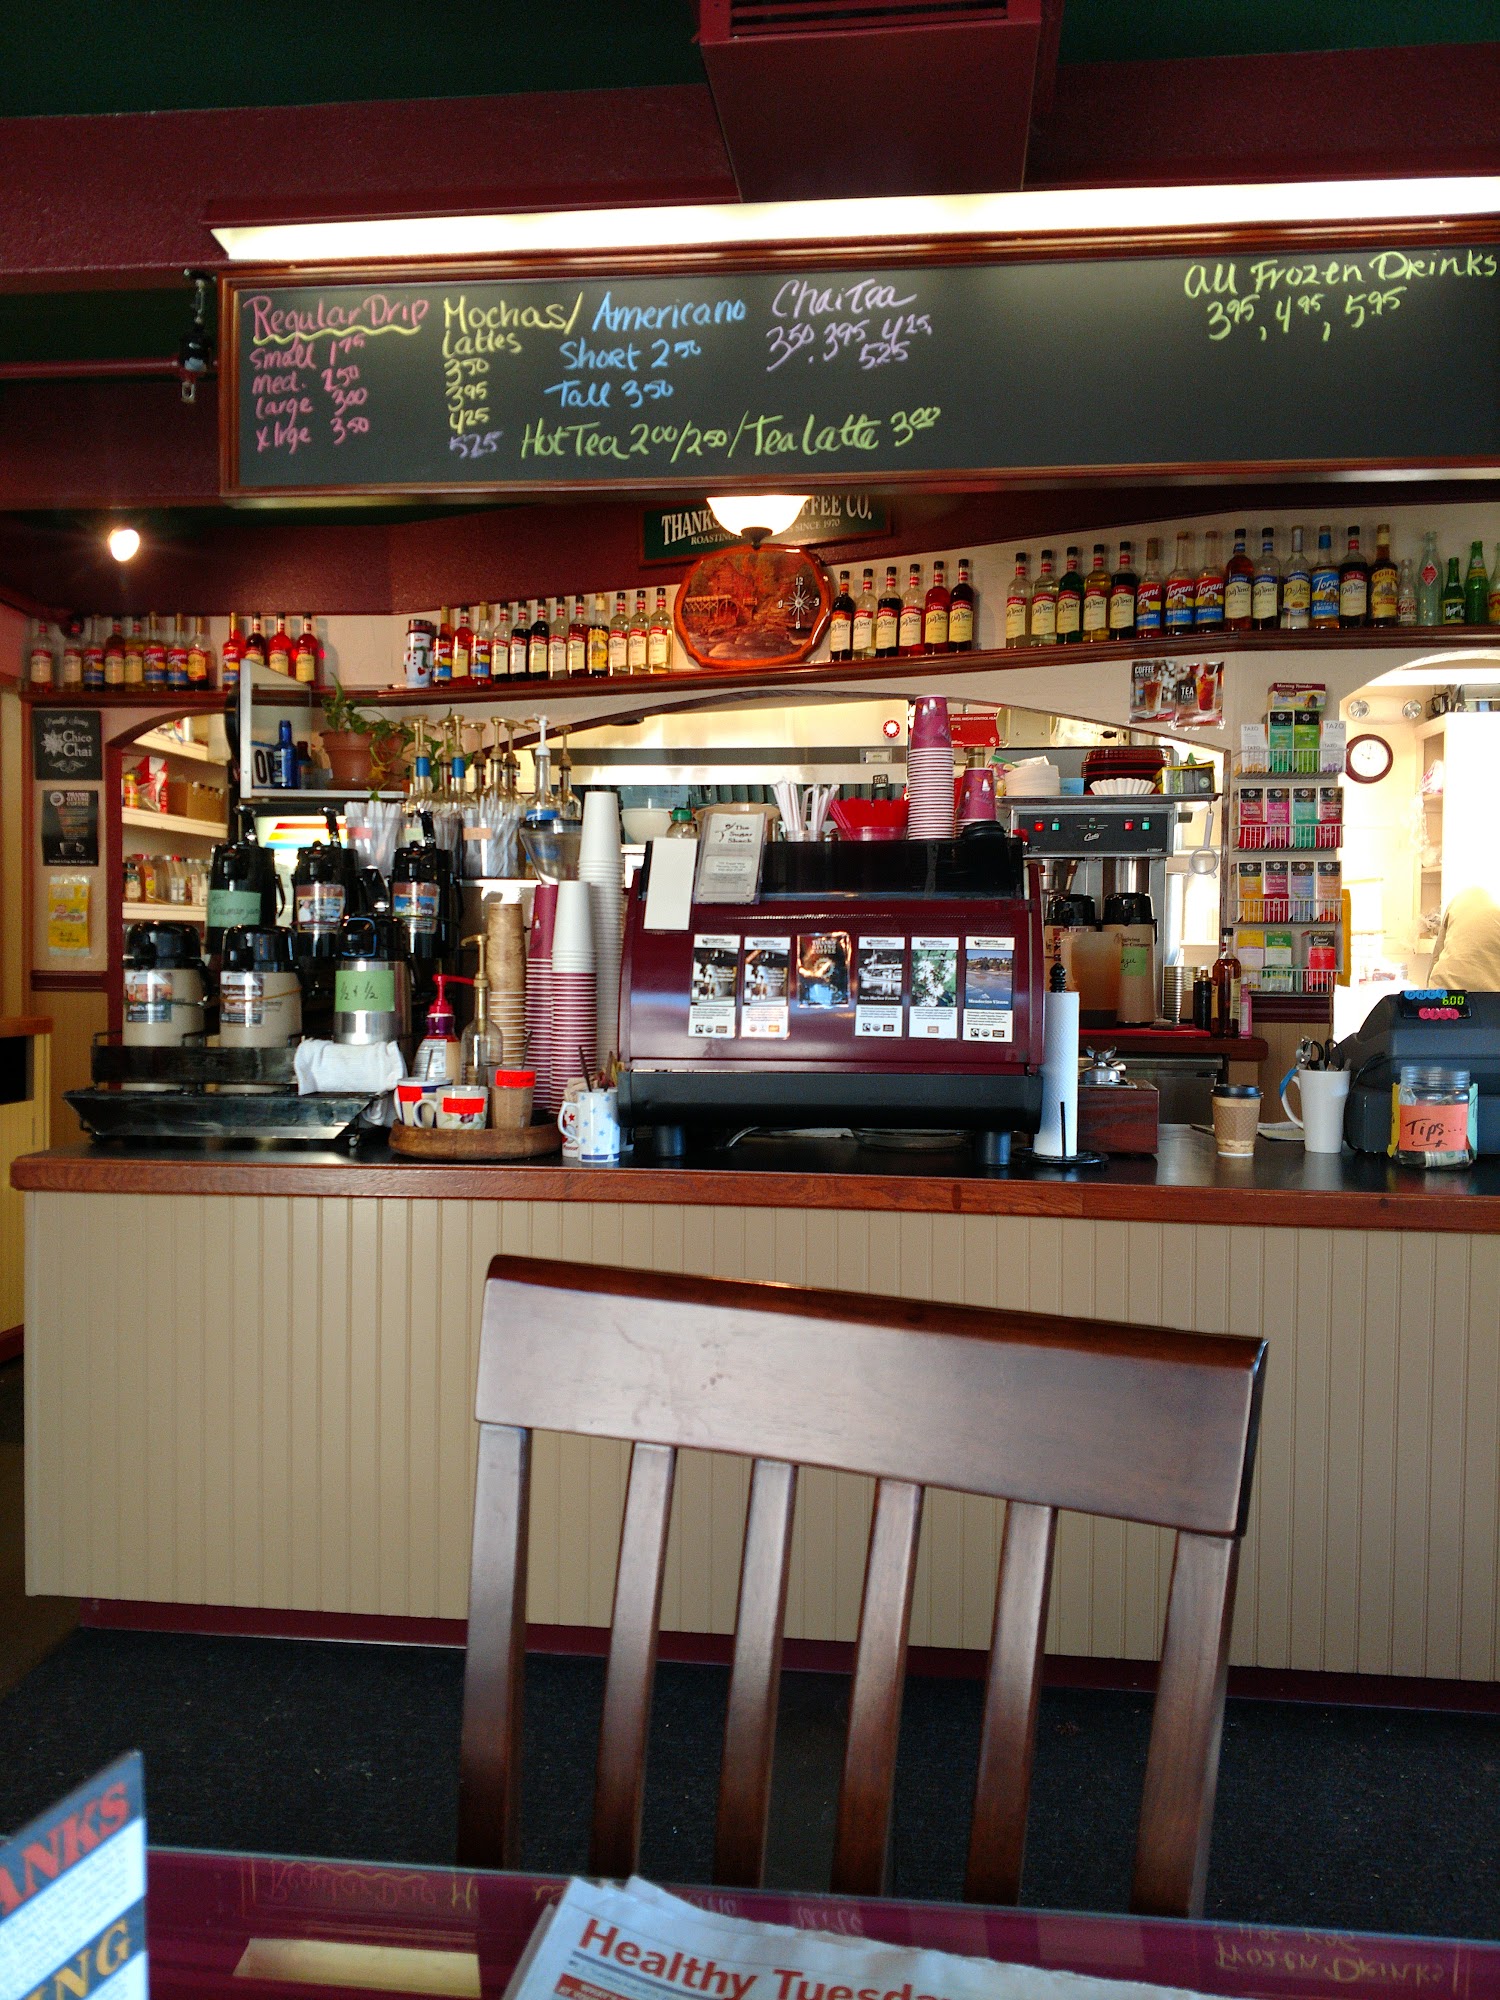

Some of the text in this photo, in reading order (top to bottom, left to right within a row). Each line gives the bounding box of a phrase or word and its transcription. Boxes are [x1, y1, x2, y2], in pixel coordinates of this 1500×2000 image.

[1250, 259, 1367, 294] Frozen
[771, 279, 917, 319] Chai Tea
[243, 293, 429, 352] Regular Drip
[592, 291, 747, 333] Americano
[545, 380, 610, 408] Tall
[521, 417, 570, 460] Hot
[565, 421, 630, 460] Tea
[823, 518, 841, 529] 1970
[1167, 582, 1194, 602] Torani
[1135, 666, 1155, 674] COFFEE
[1181, 687, 1195, 695] TEA
[63, 730, 93, 743] Chico
[1325, 722, 1344, 730] TAZO
[63, 742, 93, 757] Chai
[578, 1918, 758, 2000] Healthy
